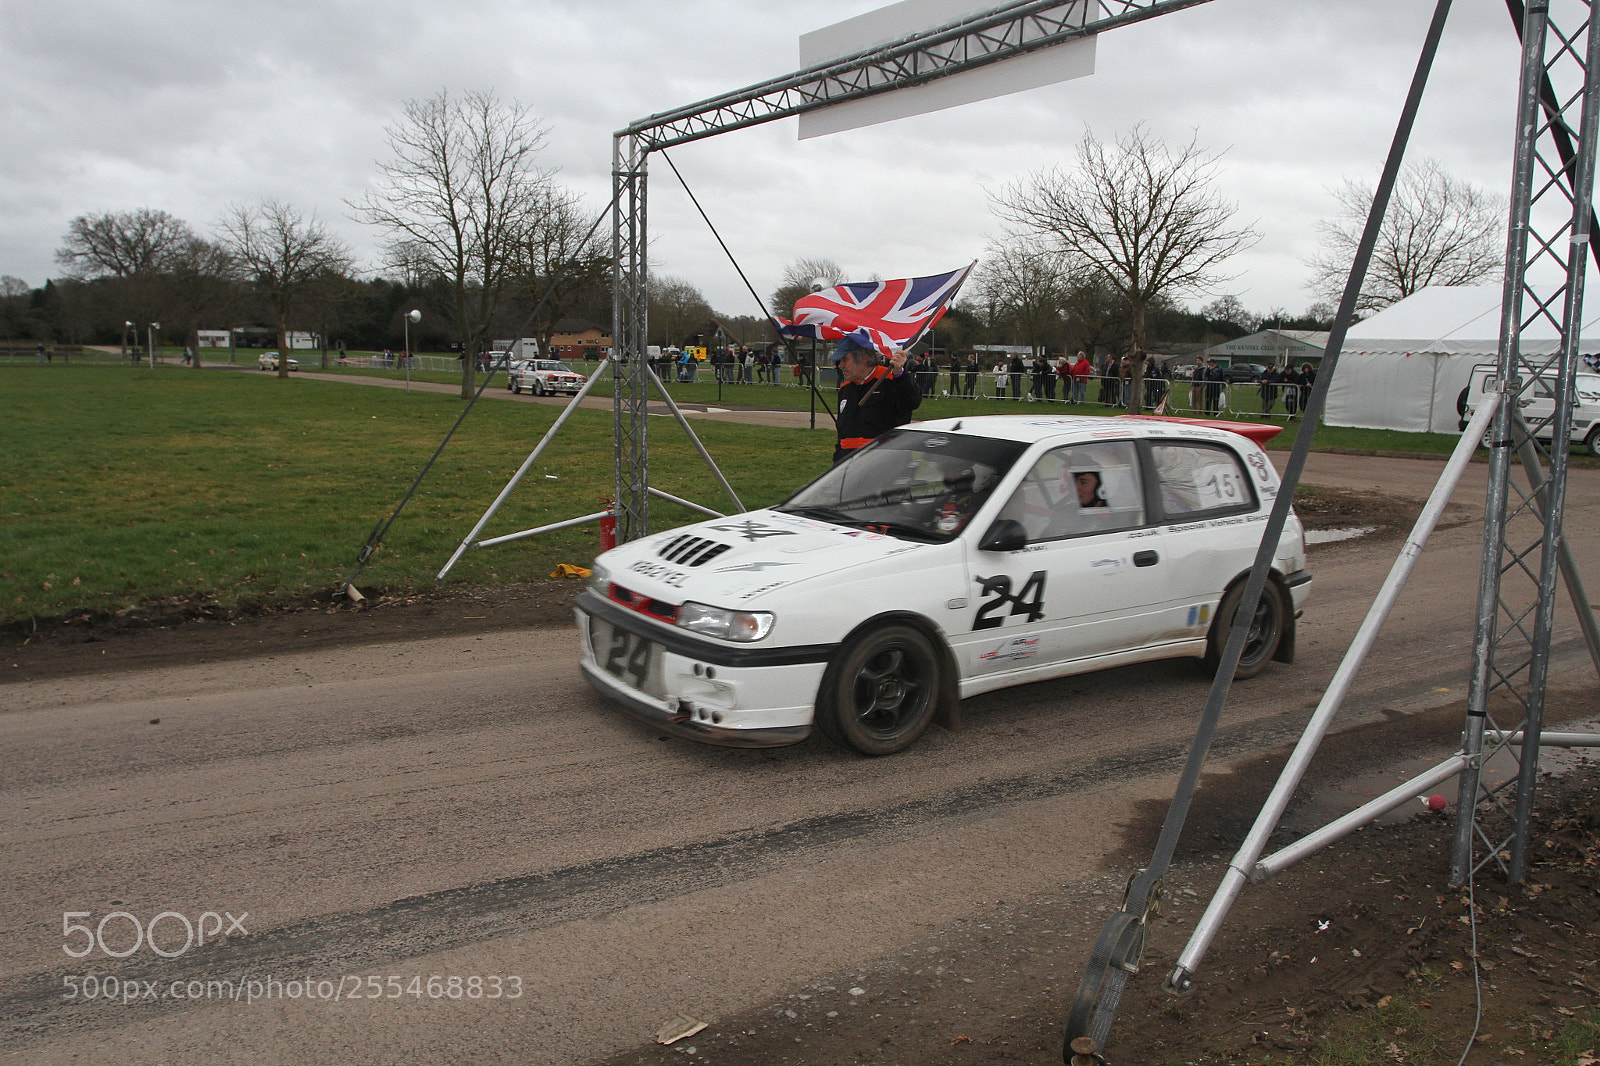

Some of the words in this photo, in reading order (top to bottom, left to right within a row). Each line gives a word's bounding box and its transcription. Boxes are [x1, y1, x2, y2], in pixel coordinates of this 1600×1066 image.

[1207, 474, 1235, 498] 15
[1168, 522, 1206, 533] Special
[1209, 516, 1244, 528] Vehicle
[971, 570, 1047, 631] 24
[606, 627, 652, 689] 24
